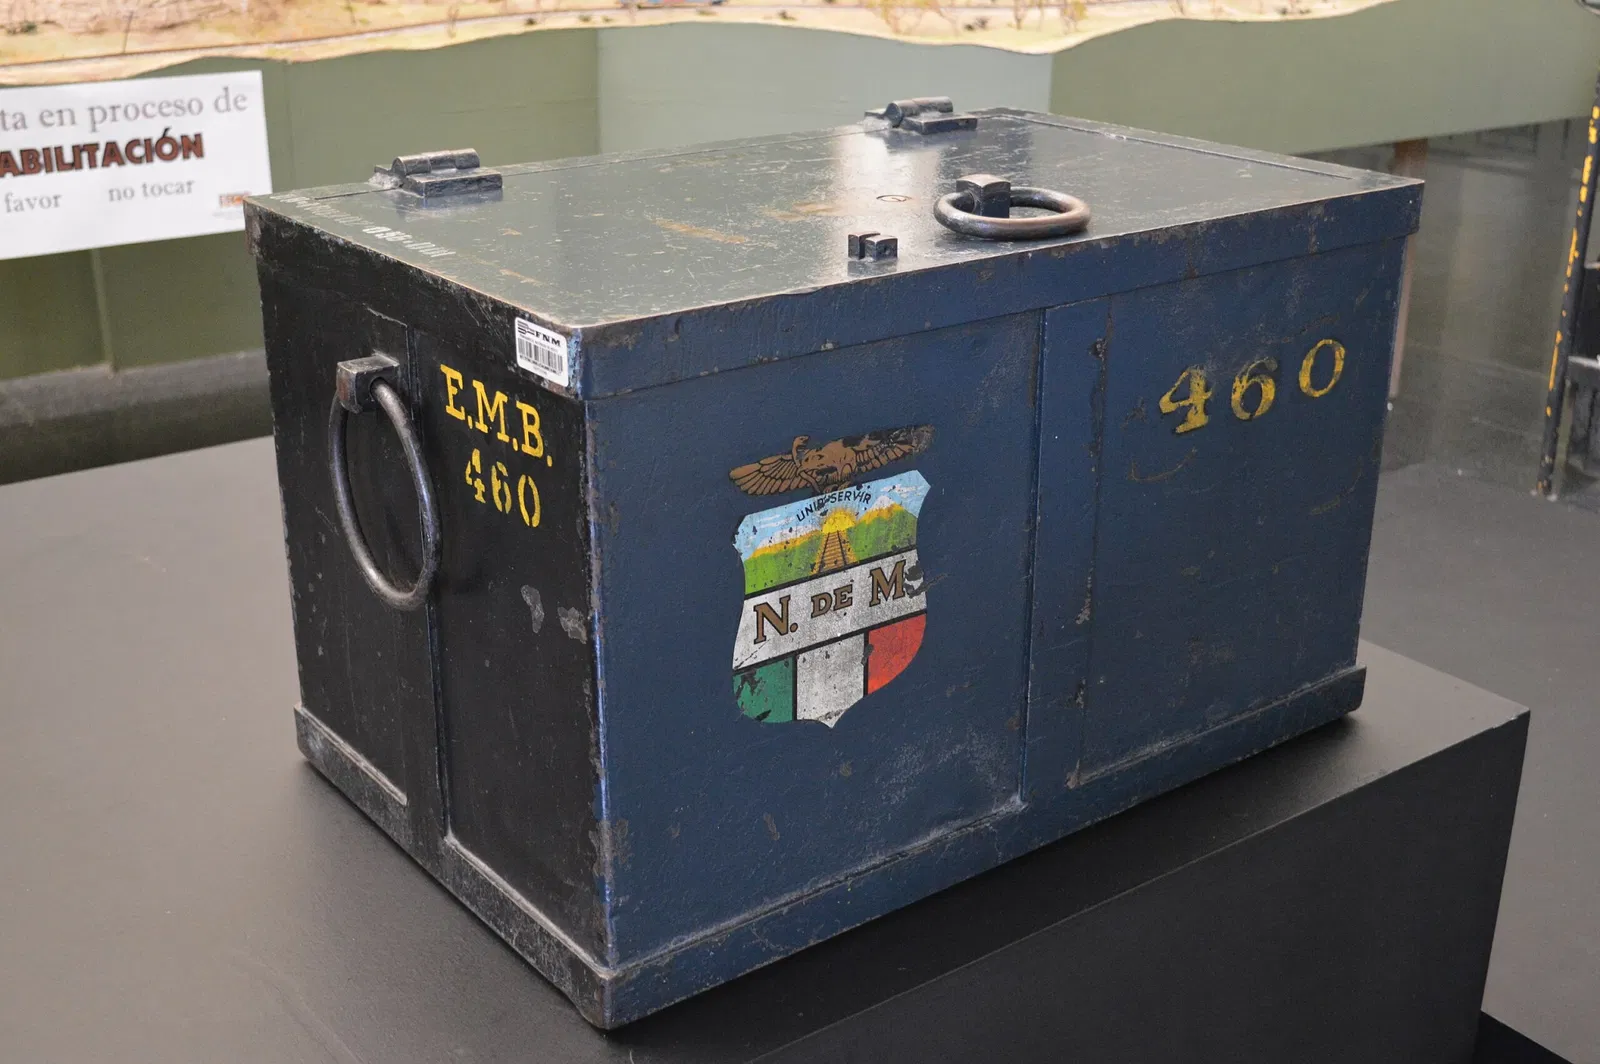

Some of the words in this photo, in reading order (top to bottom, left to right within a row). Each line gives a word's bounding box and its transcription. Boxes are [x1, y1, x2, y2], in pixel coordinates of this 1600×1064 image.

[39, 107, 77, 128] en
[88, 97, 204, 133] proceso
[213, 86, 249, 114] de
[0, 127, 205, 178] ABILITACIÓN
[4, 191, 62, 214] favor
[108, 186, 135, 203] no
[140, 179, 195, 198] tocar
[440, 363, 553, 467] E.M.B.
[1158, 338, 1346, 434] 460
[465, 448, 542, 528] 460
[753, 594, 799, 645] N.
[810, 583, 853, 619] DE
